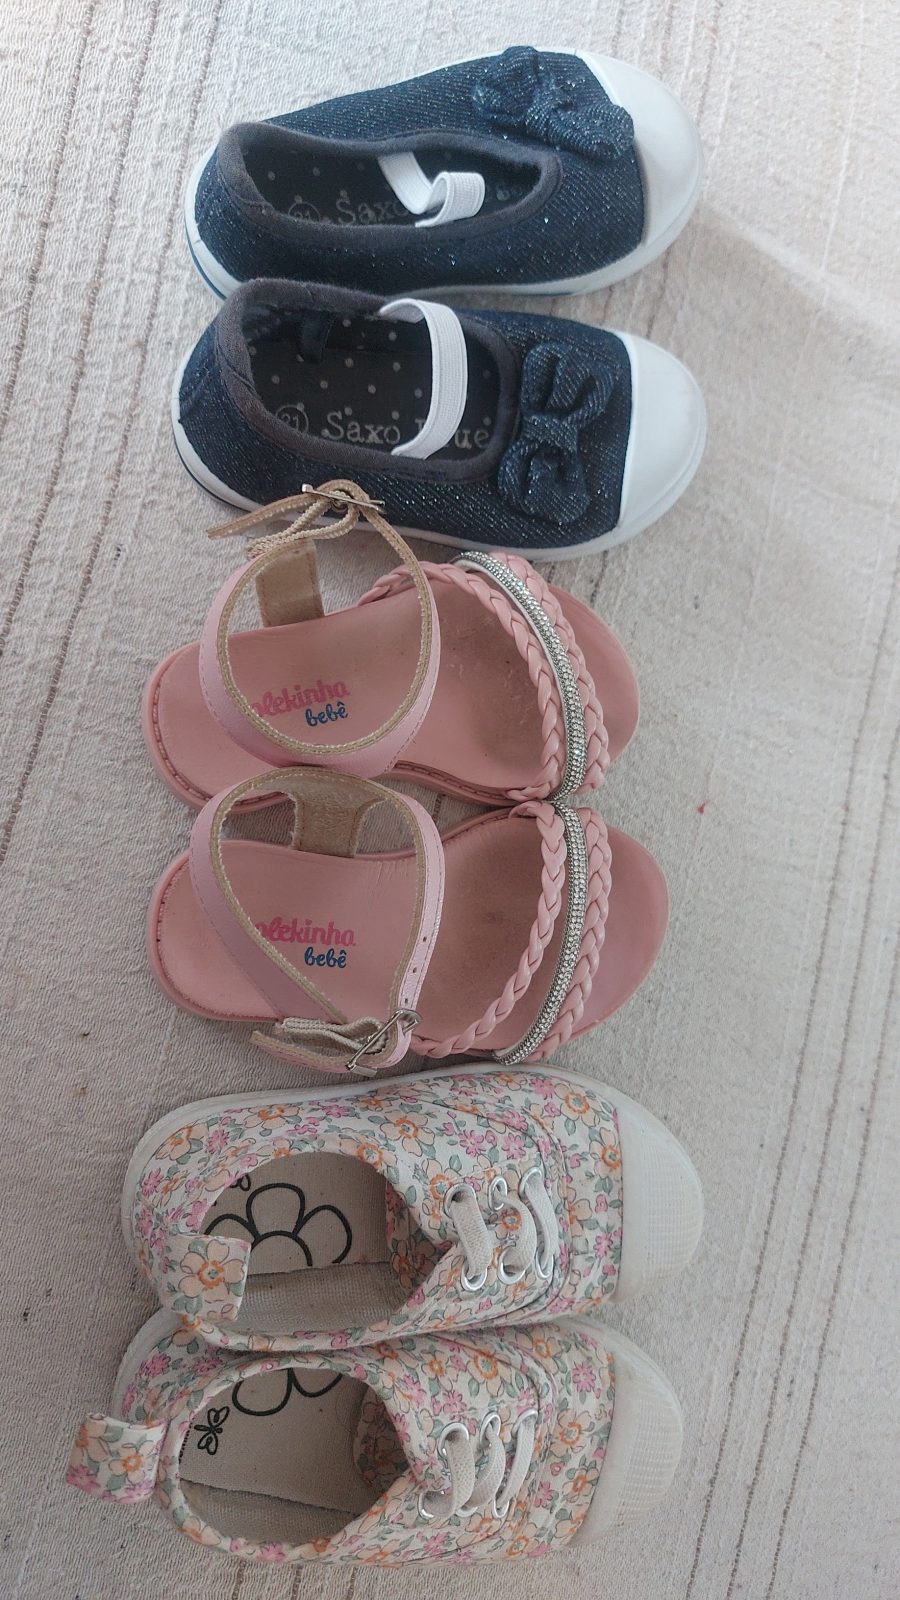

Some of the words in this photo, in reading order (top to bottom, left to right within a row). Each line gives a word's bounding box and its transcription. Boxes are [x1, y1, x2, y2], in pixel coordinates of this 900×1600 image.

[325, 411, 400, 444] Saxo
[414, 417, 489, 450] ue
[305, 701, 348, 727] bebê
[304, 946, 347, 969] bebê
